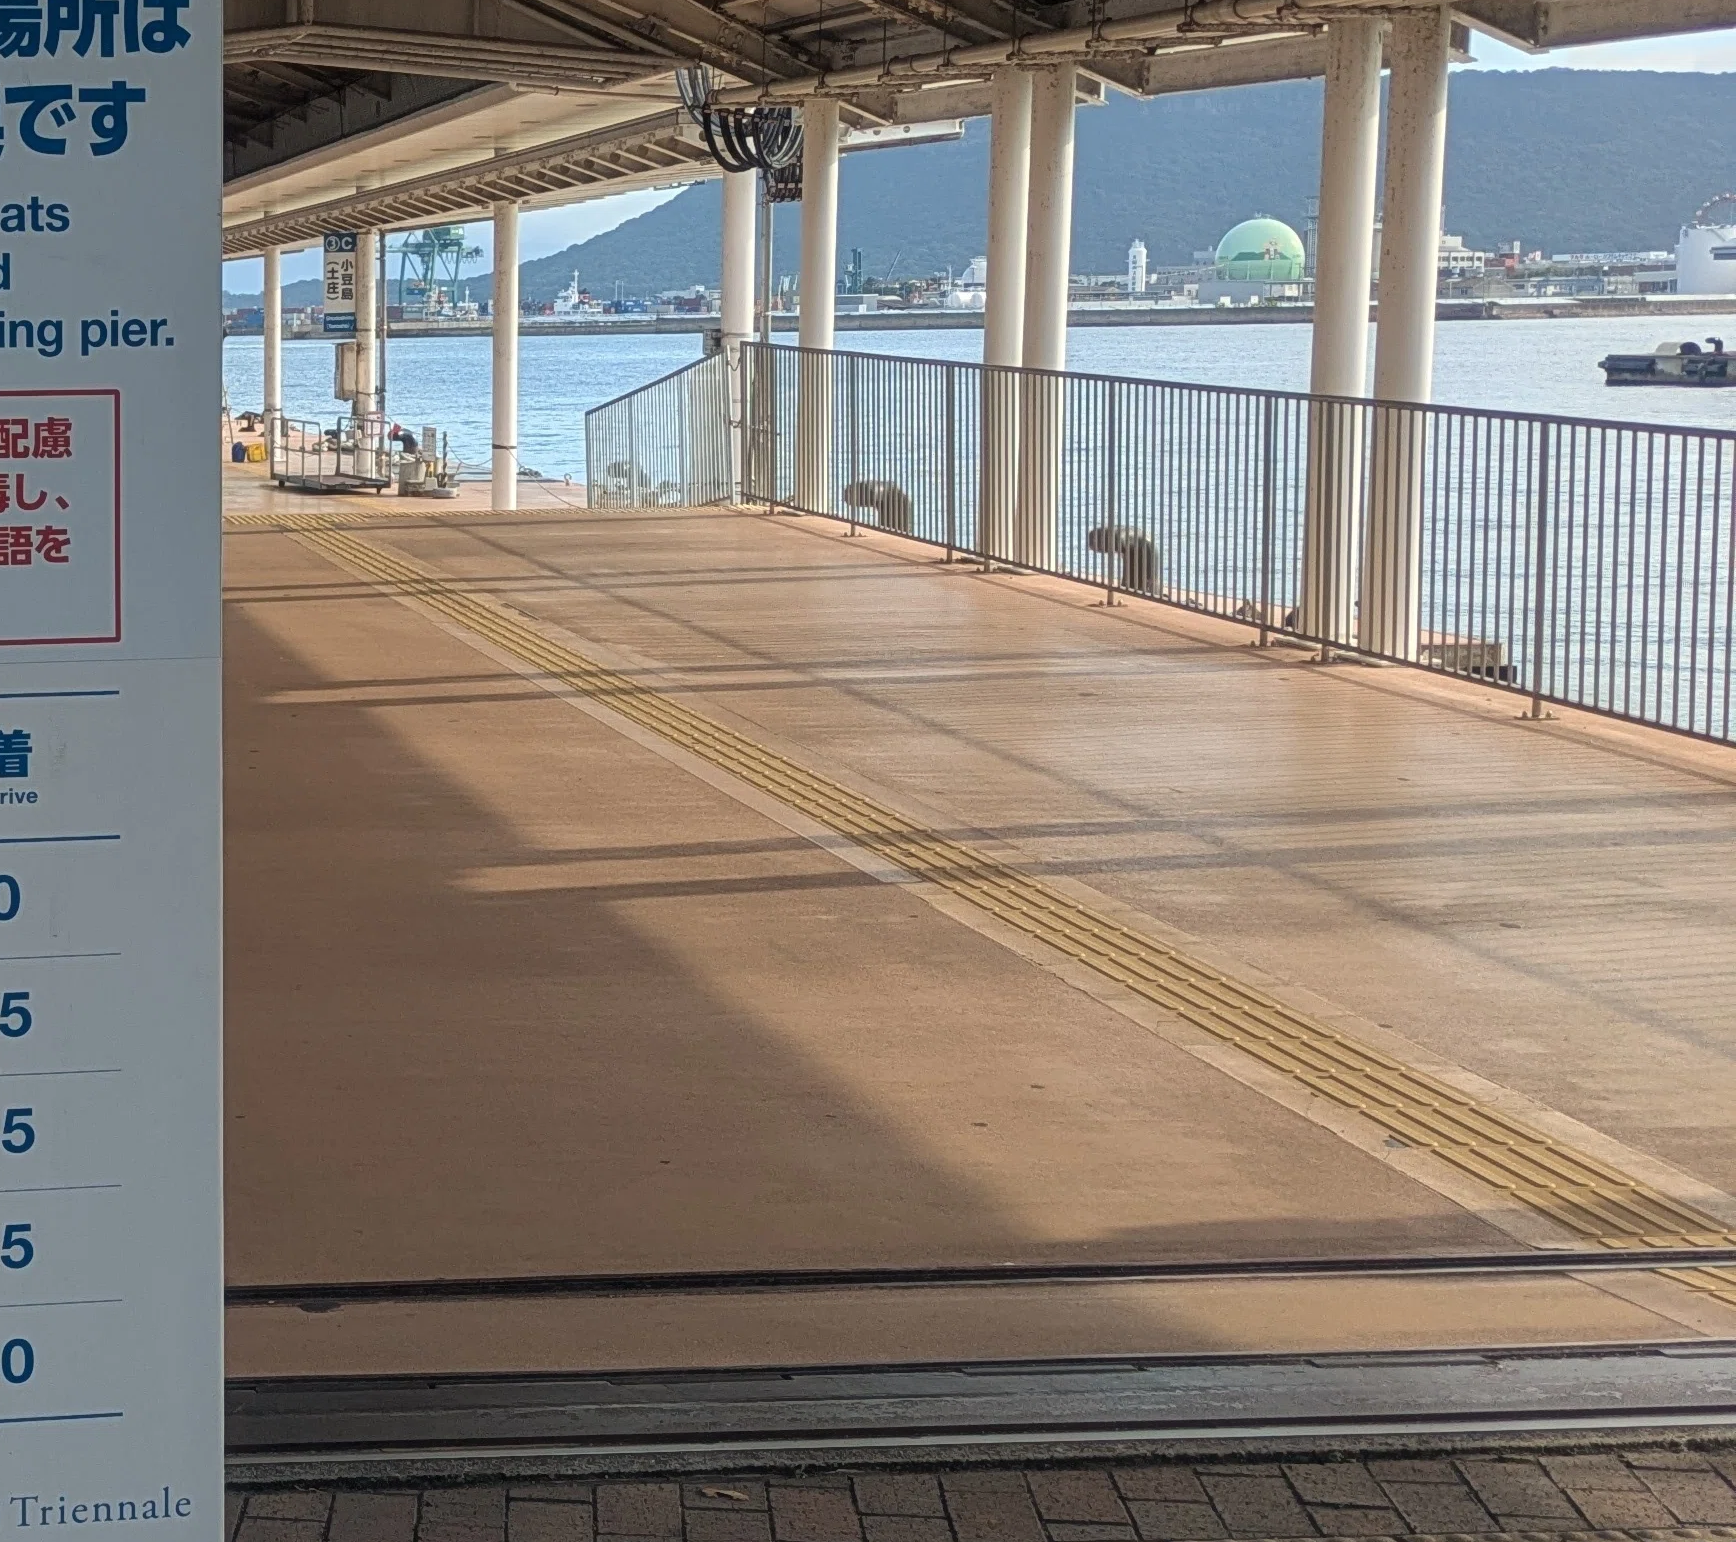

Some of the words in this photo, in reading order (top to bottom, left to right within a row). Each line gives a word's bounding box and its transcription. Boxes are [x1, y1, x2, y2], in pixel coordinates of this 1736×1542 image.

[341, 236, 353, 250] C
[340, 258, 354, 300] 小豆島
[80, 309, 175, 357] pier.
[9, 1485, 191, 1527] Triennale
